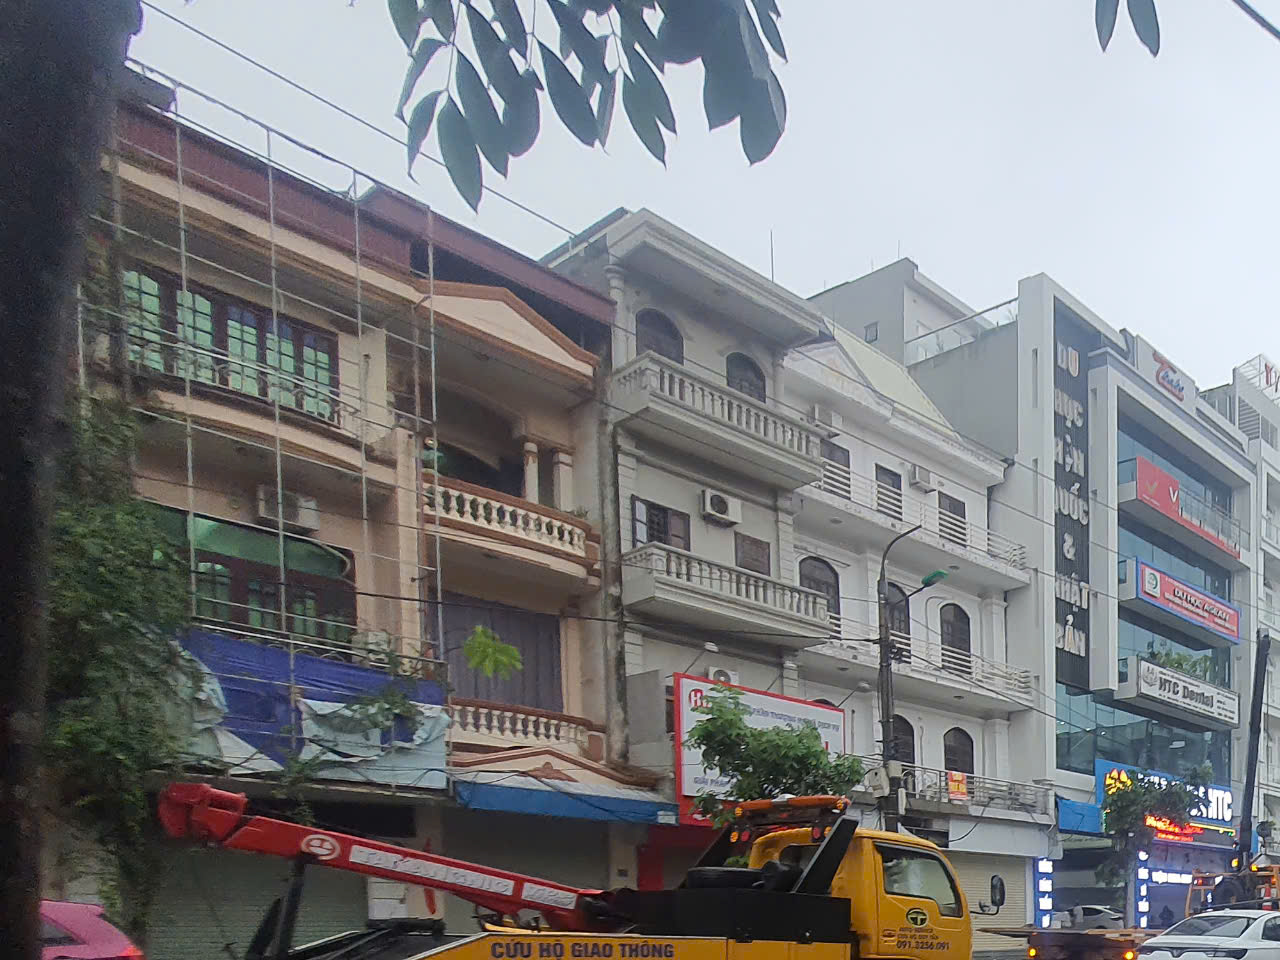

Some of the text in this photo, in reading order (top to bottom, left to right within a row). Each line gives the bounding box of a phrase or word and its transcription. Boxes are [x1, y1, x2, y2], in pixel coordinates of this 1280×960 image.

[1057, 341, 1079, 377] DU
[1055, 388, 1083, 428] HỌC
[1063, 532, 1076, 561] &
[1158, 677, 1180, 696] HTC
[1182, 685, 1214, 708] Dental
[1207, 788, 1232, 821] HTC
[491, 939, 675, 960] CỨU HỘ GIAO THÔNG
